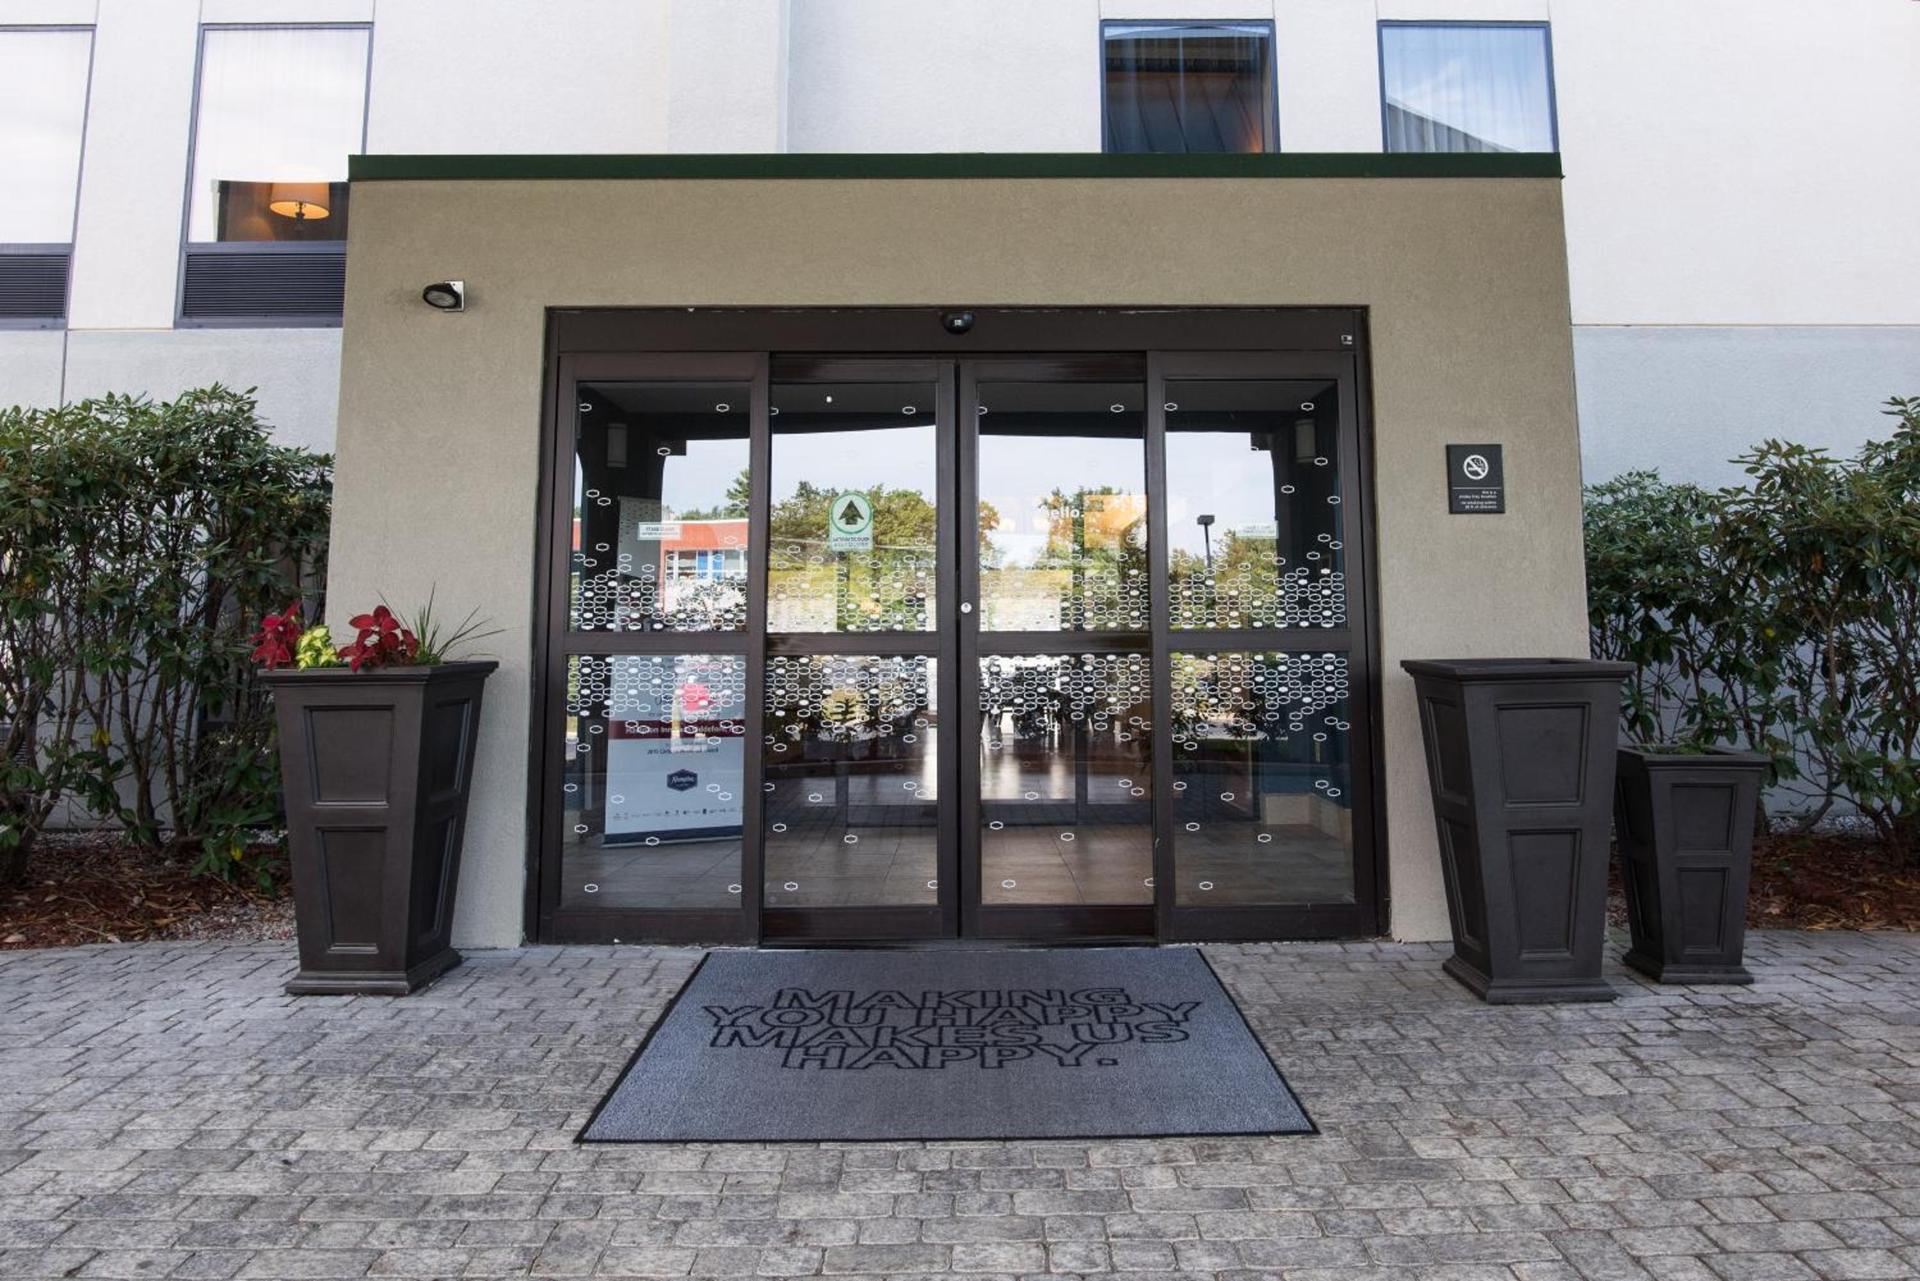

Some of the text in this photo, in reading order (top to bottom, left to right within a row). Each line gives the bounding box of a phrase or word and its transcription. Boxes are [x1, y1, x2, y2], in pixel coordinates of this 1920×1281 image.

[773, 987, 1132, 1009] MAKING
[702, 1002, 1202, 1028] YOU HAPPY
[710, 1022, 1190, 1048] MAKES US
[782, 1044, 1118, 1069] HAPPY.
